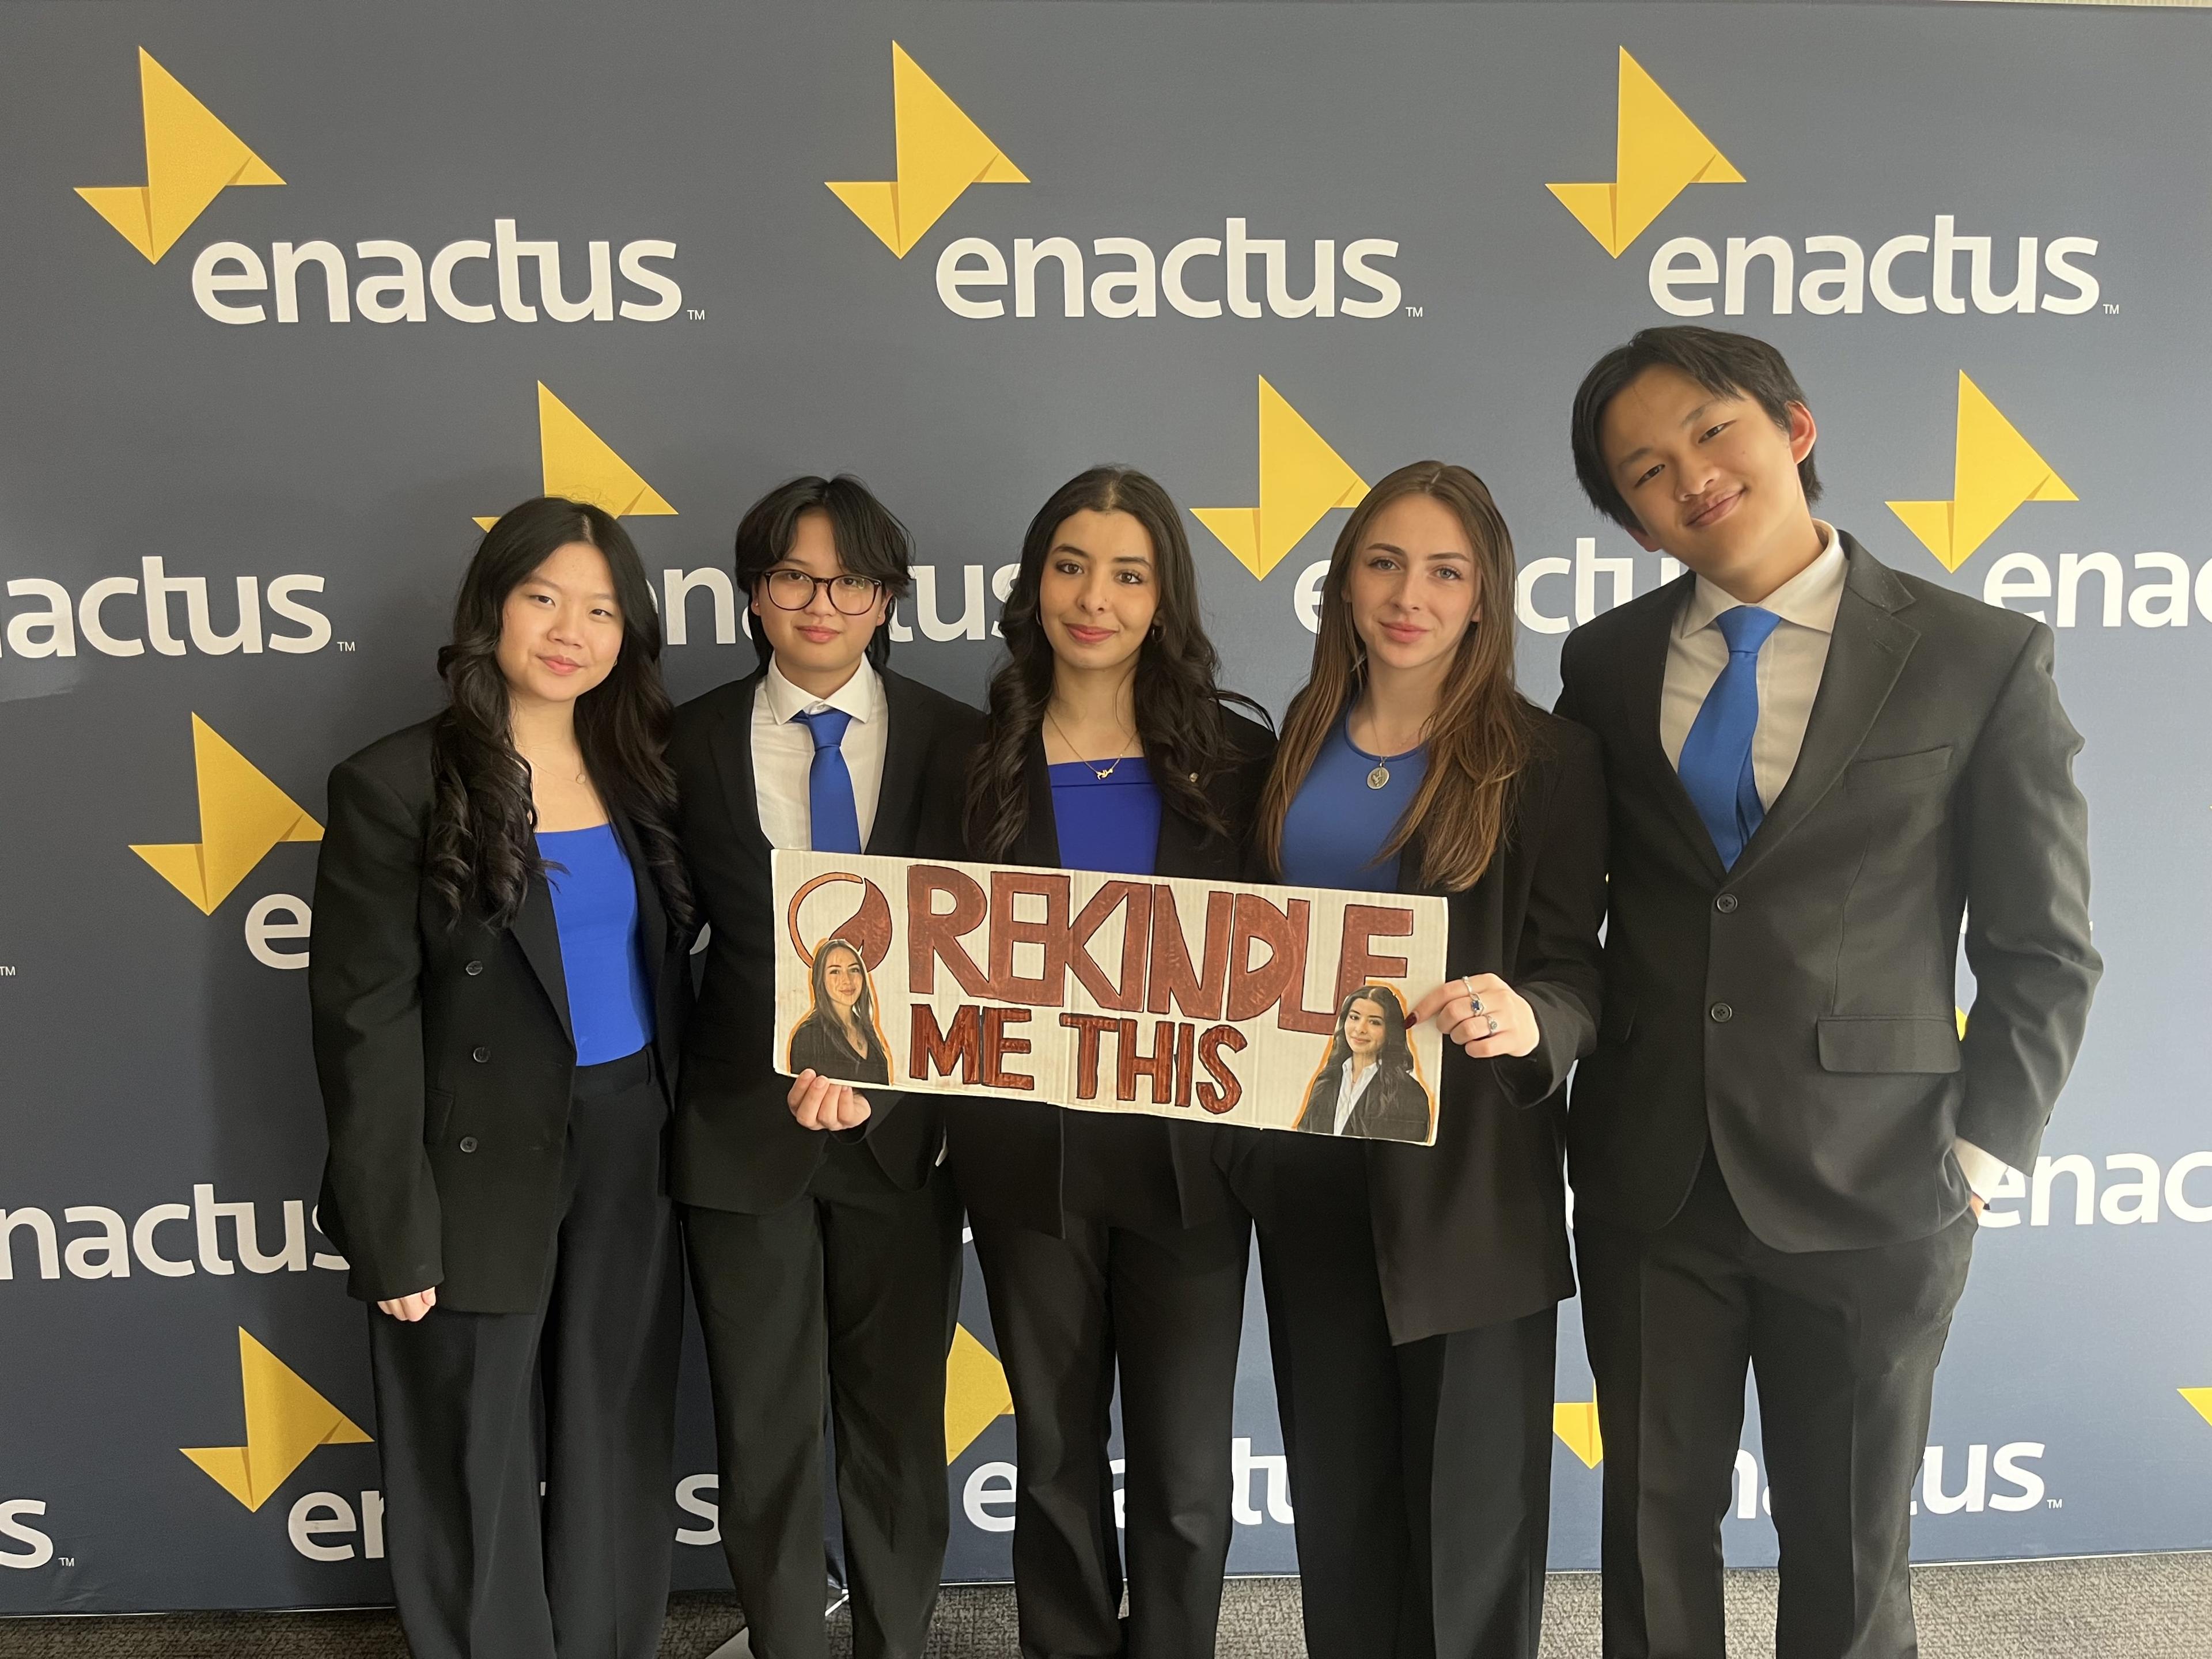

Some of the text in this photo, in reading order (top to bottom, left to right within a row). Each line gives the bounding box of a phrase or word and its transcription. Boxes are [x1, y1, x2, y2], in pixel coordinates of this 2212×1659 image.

[191, 218, 682, 324] enactus
[935, 217, 1402, 319] enactus
[1649, 214, 2100, 317] enactus
[0, 556, 332, 658] actus
[1983, 551, 2212, 628] ena
[907, 864, 1414, 1035] REKINDLE
[910, 1003, 1248, 1115] ME THIS
